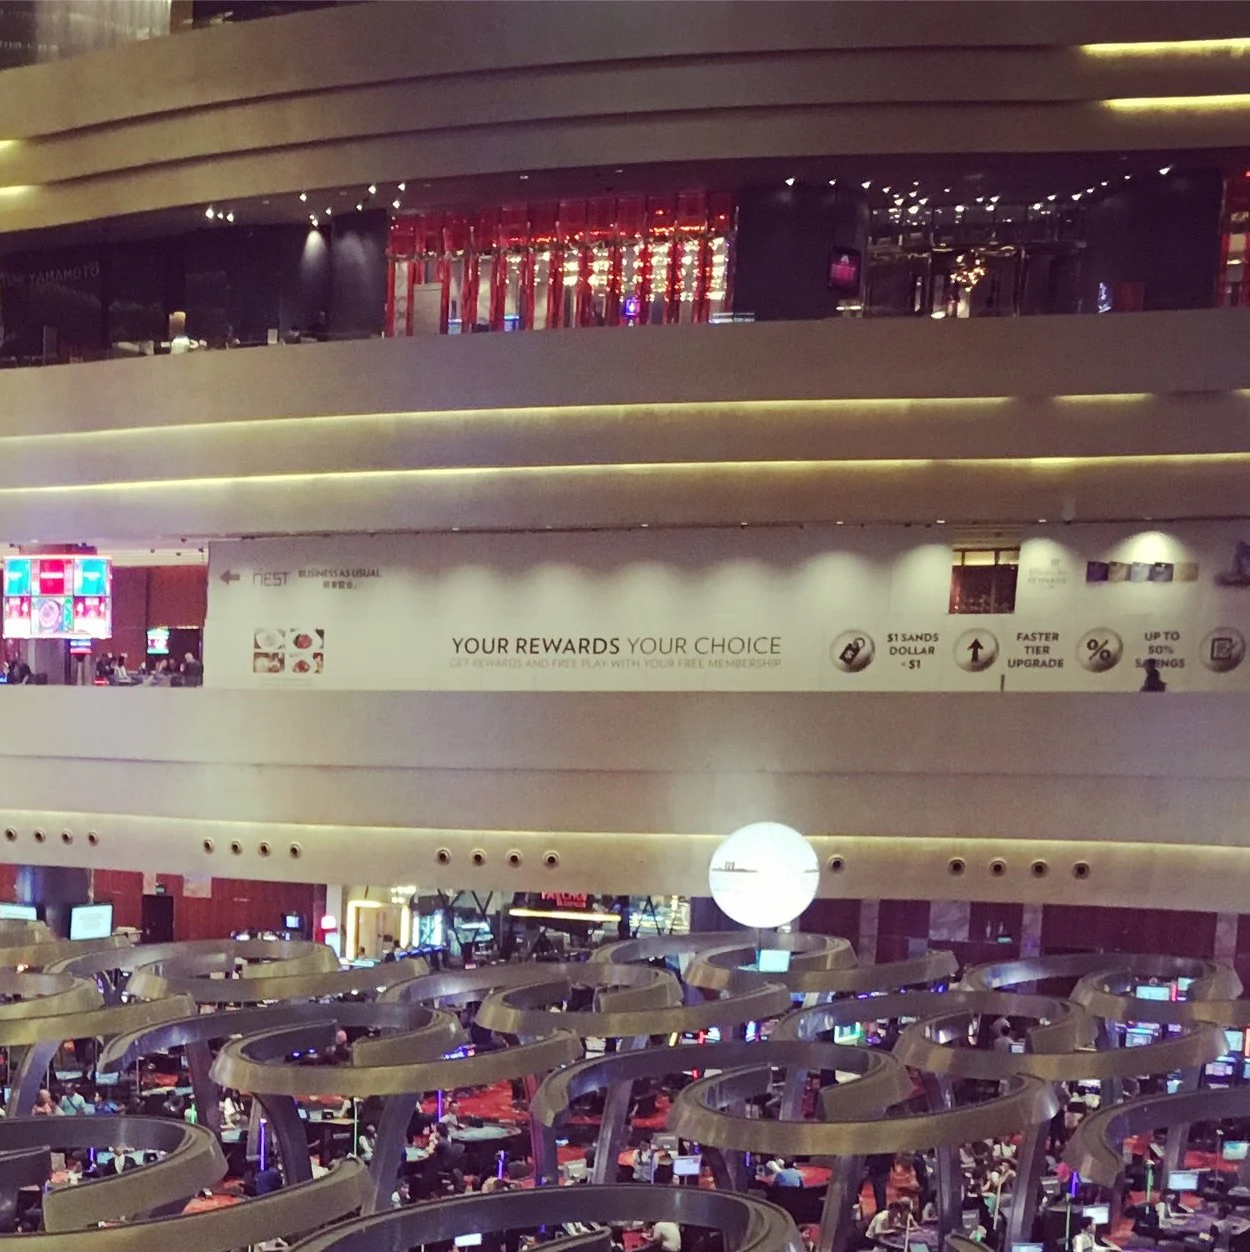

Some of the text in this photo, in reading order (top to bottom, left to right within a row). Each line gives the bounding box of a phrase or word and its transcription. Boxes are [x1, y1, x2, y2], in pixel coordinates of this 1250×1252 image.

[298, 569, 338, 578] BUSINESS
[339, 568, 351, 577] AS
[901, 633, 939, 642] SANDS
[1016, 632, 1060, 642] FASTER
[1144, 631, 1180, 641] UP TO
[452, 636, 781, 655] YOUR REWARDS YOUR CHOICE
[889, 646, 935, 655] DOLLAR
[1024, 646, 1050, 655] TIER
[449, 658, 782, 669] GET REWARDS AND FREE PLAY WITH YOUR FREE MEMBERSHIP
[908, 659, 921, 669] $1
[1007, 658, 1064, 668] UPGRADE
[1135, 658, 1185, 668] SINGS
